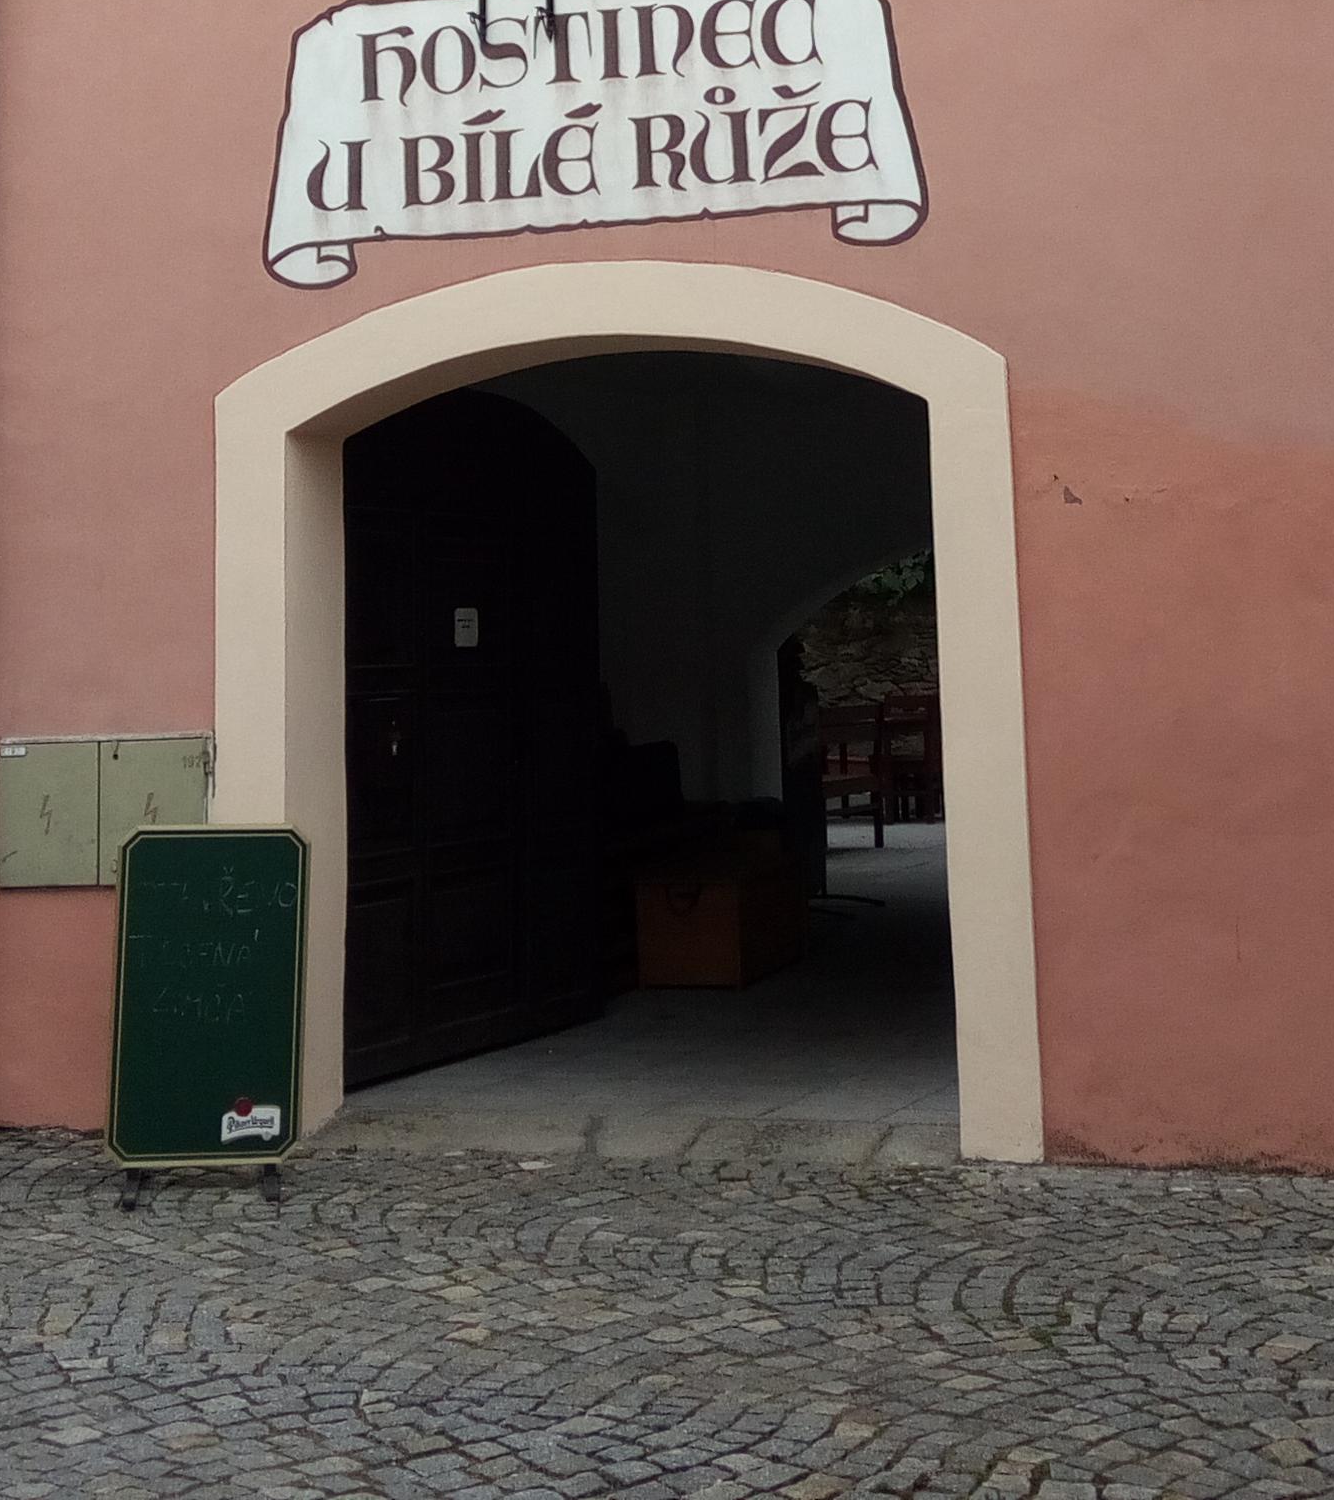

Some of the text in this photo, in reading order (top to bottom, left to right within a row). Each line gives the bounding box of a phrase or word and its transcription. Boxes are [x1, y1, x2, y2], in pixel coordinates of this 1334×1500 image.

[306, 81, 880, 213] U BÍLÉ RŮŽE
